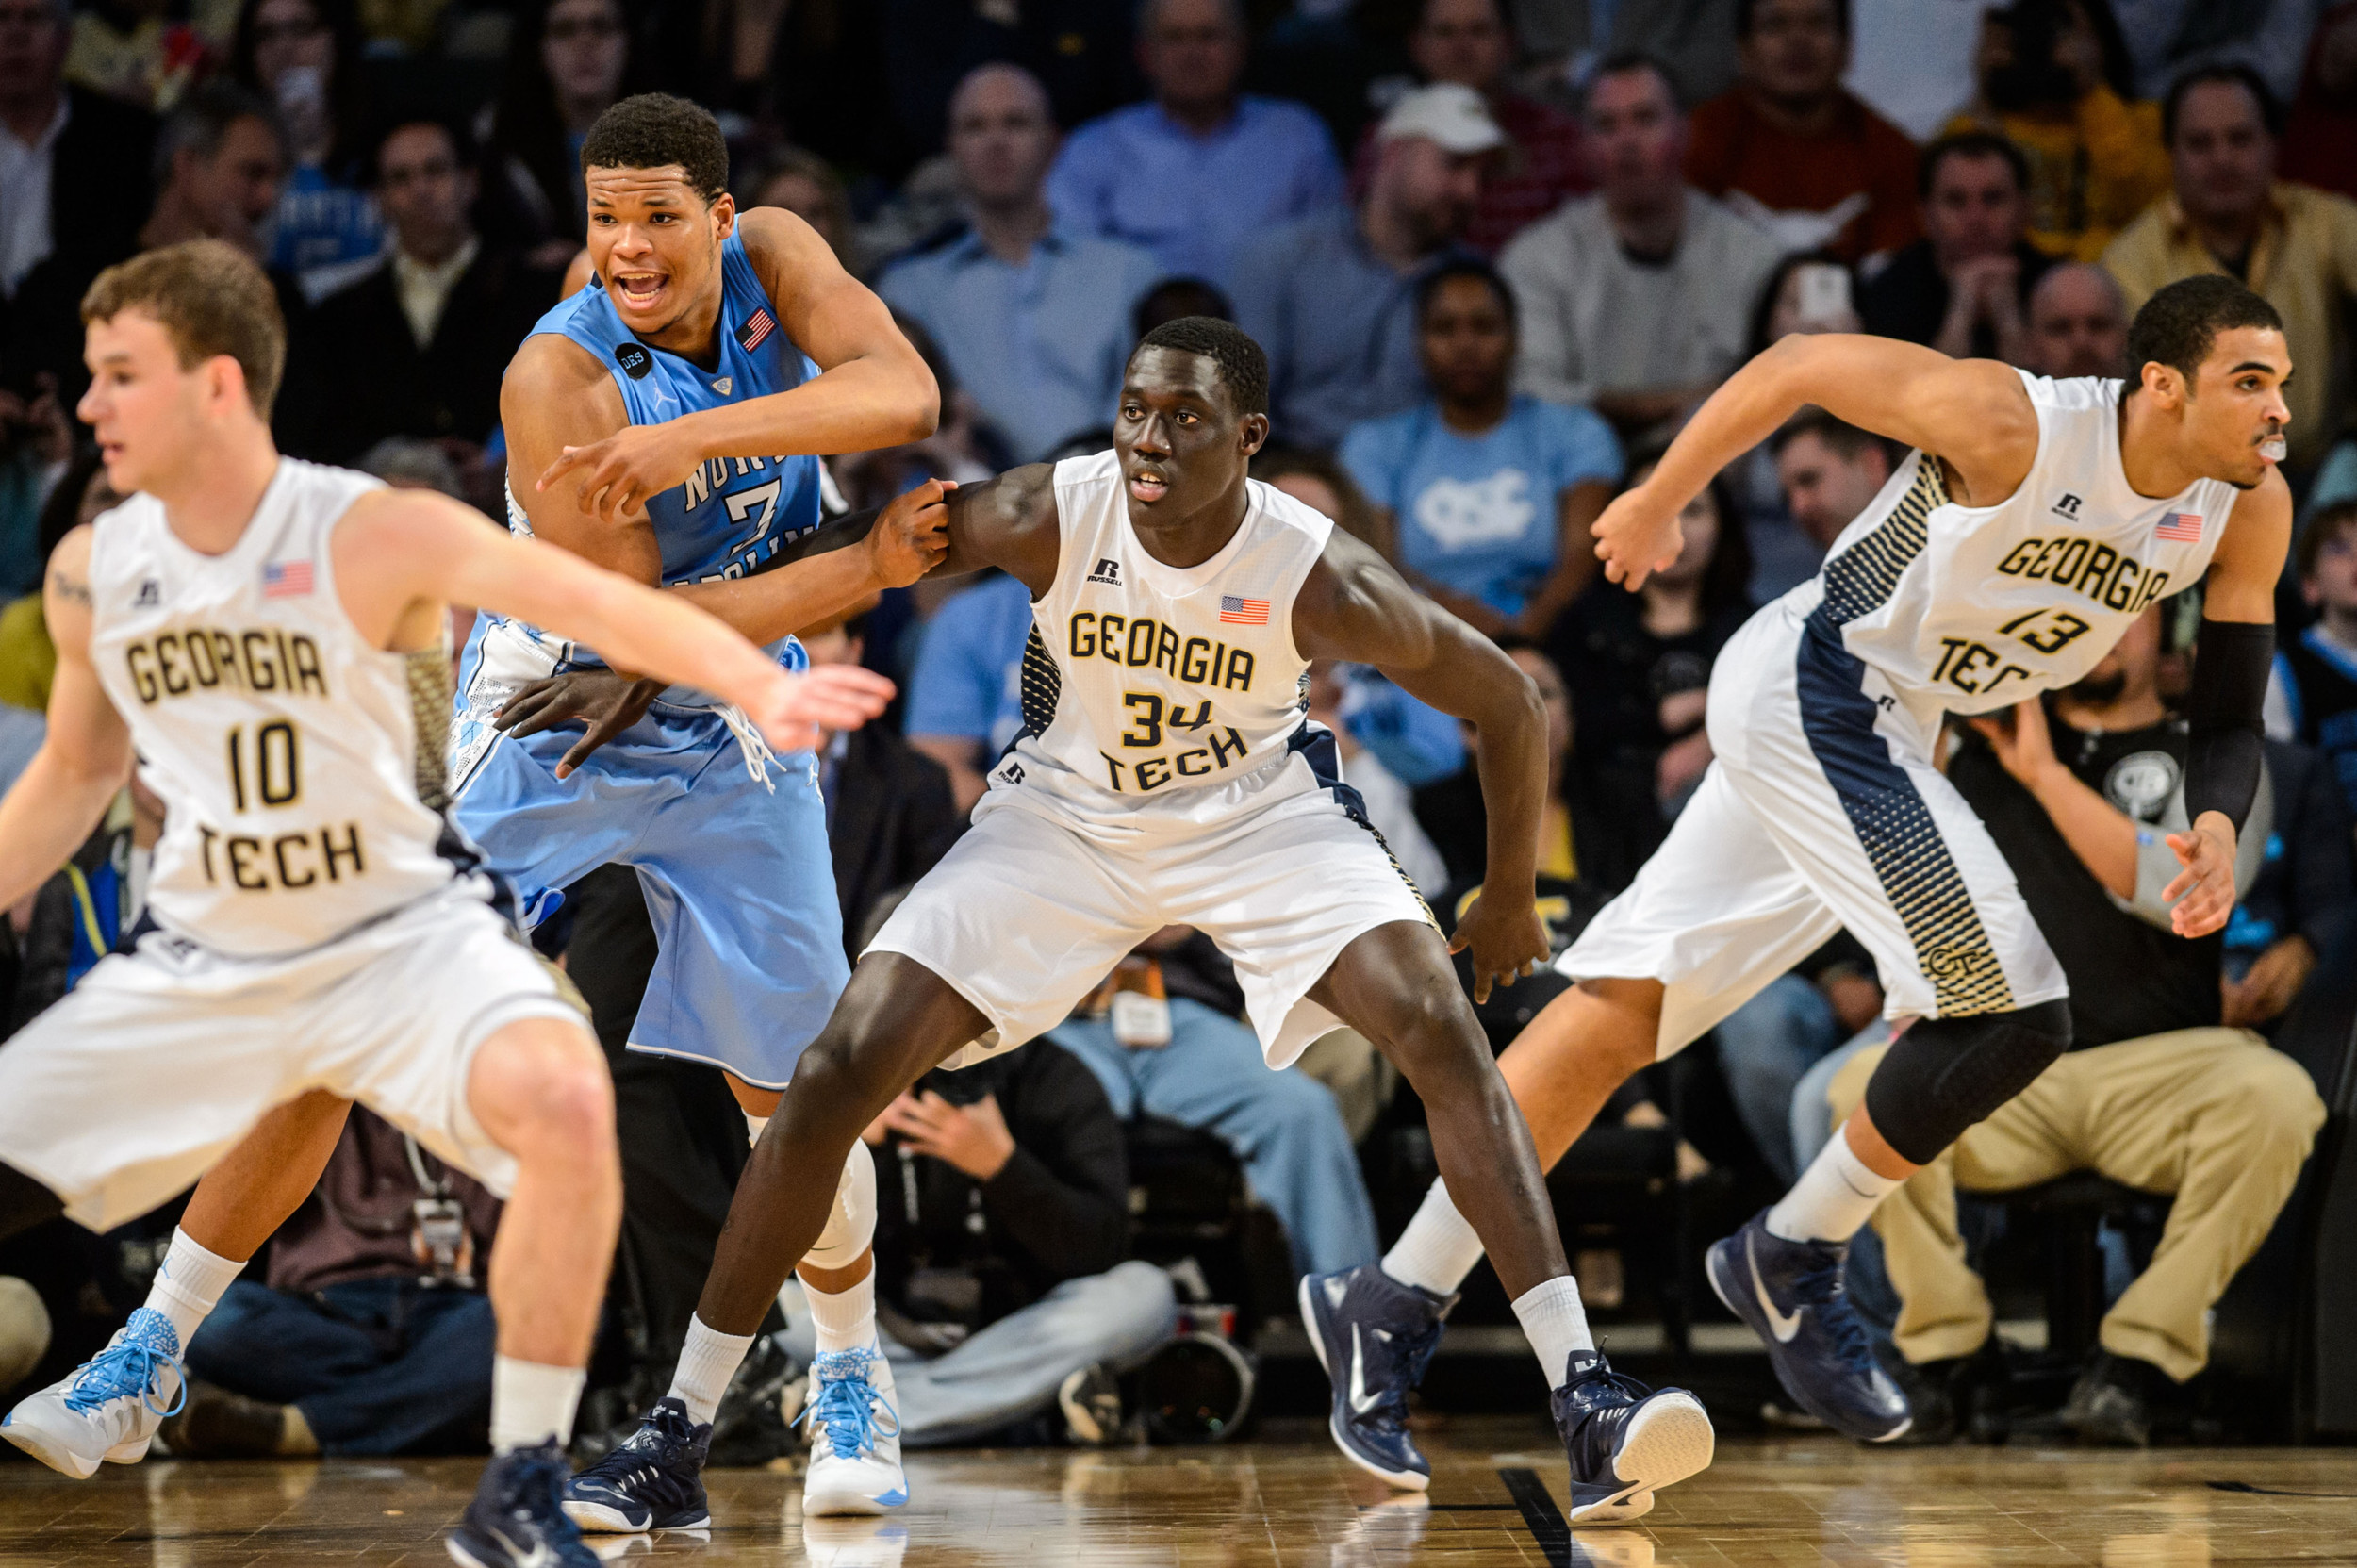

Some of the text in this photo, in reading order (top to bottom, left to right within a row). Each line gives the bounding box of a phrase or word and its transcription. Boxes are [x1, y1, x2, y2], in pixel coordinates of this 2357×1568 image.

[621, 352, 644, 369] DES
[1086, 575, 1123, 586] RUSSELL
[1996, 536, 2170, 614] GEORGIA
[1067, 608, 1257, 694] GEORGIA
[1930, 635, 2031, 695] TEC
[1993, 605, 2093, 654] 13
[124, 626, 330, 706] GEORGIA
[1120, 689, 1216, 749] 34
[224, 717, 302, 814] 10
[1098, 722, 1250, 793] TECH
[196, 819, 369, 894] TECH
